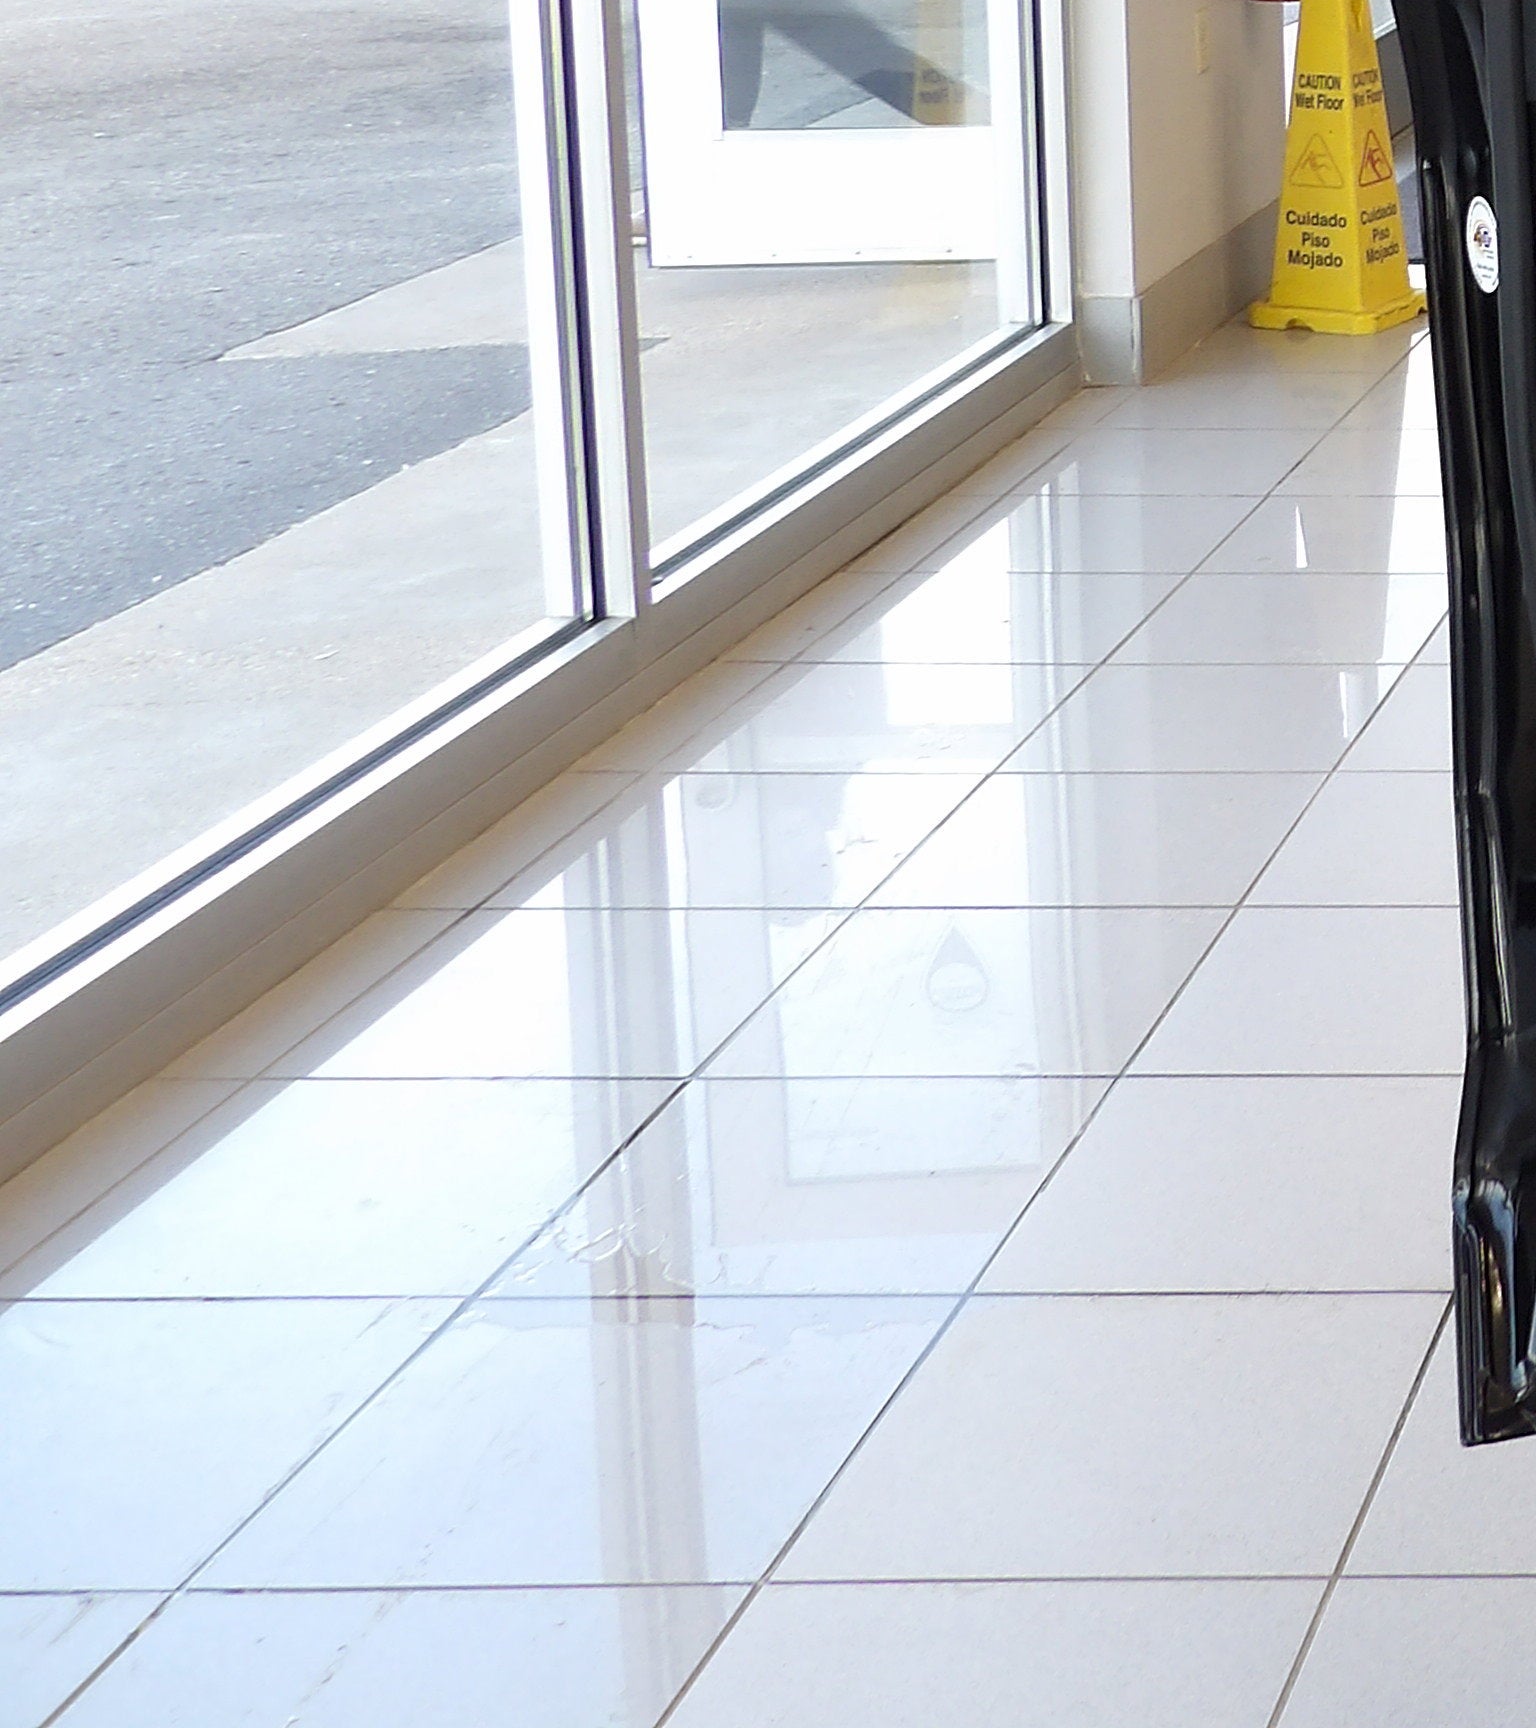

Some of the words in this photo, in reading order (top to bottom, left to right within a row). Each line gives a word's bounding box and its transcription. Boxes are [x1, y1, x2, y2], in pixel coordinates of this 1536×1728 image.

[1299, 73, 1341, 90] CAUTION
[1295, 92, 1314, 109] Wet
[1316, 93, 1344, 110] Floor
[1286, 210, 1347, 228] Cuidado
[1301, 232, 1330, 248] Piso
[1288, 250, 1343, 270] Mojado
